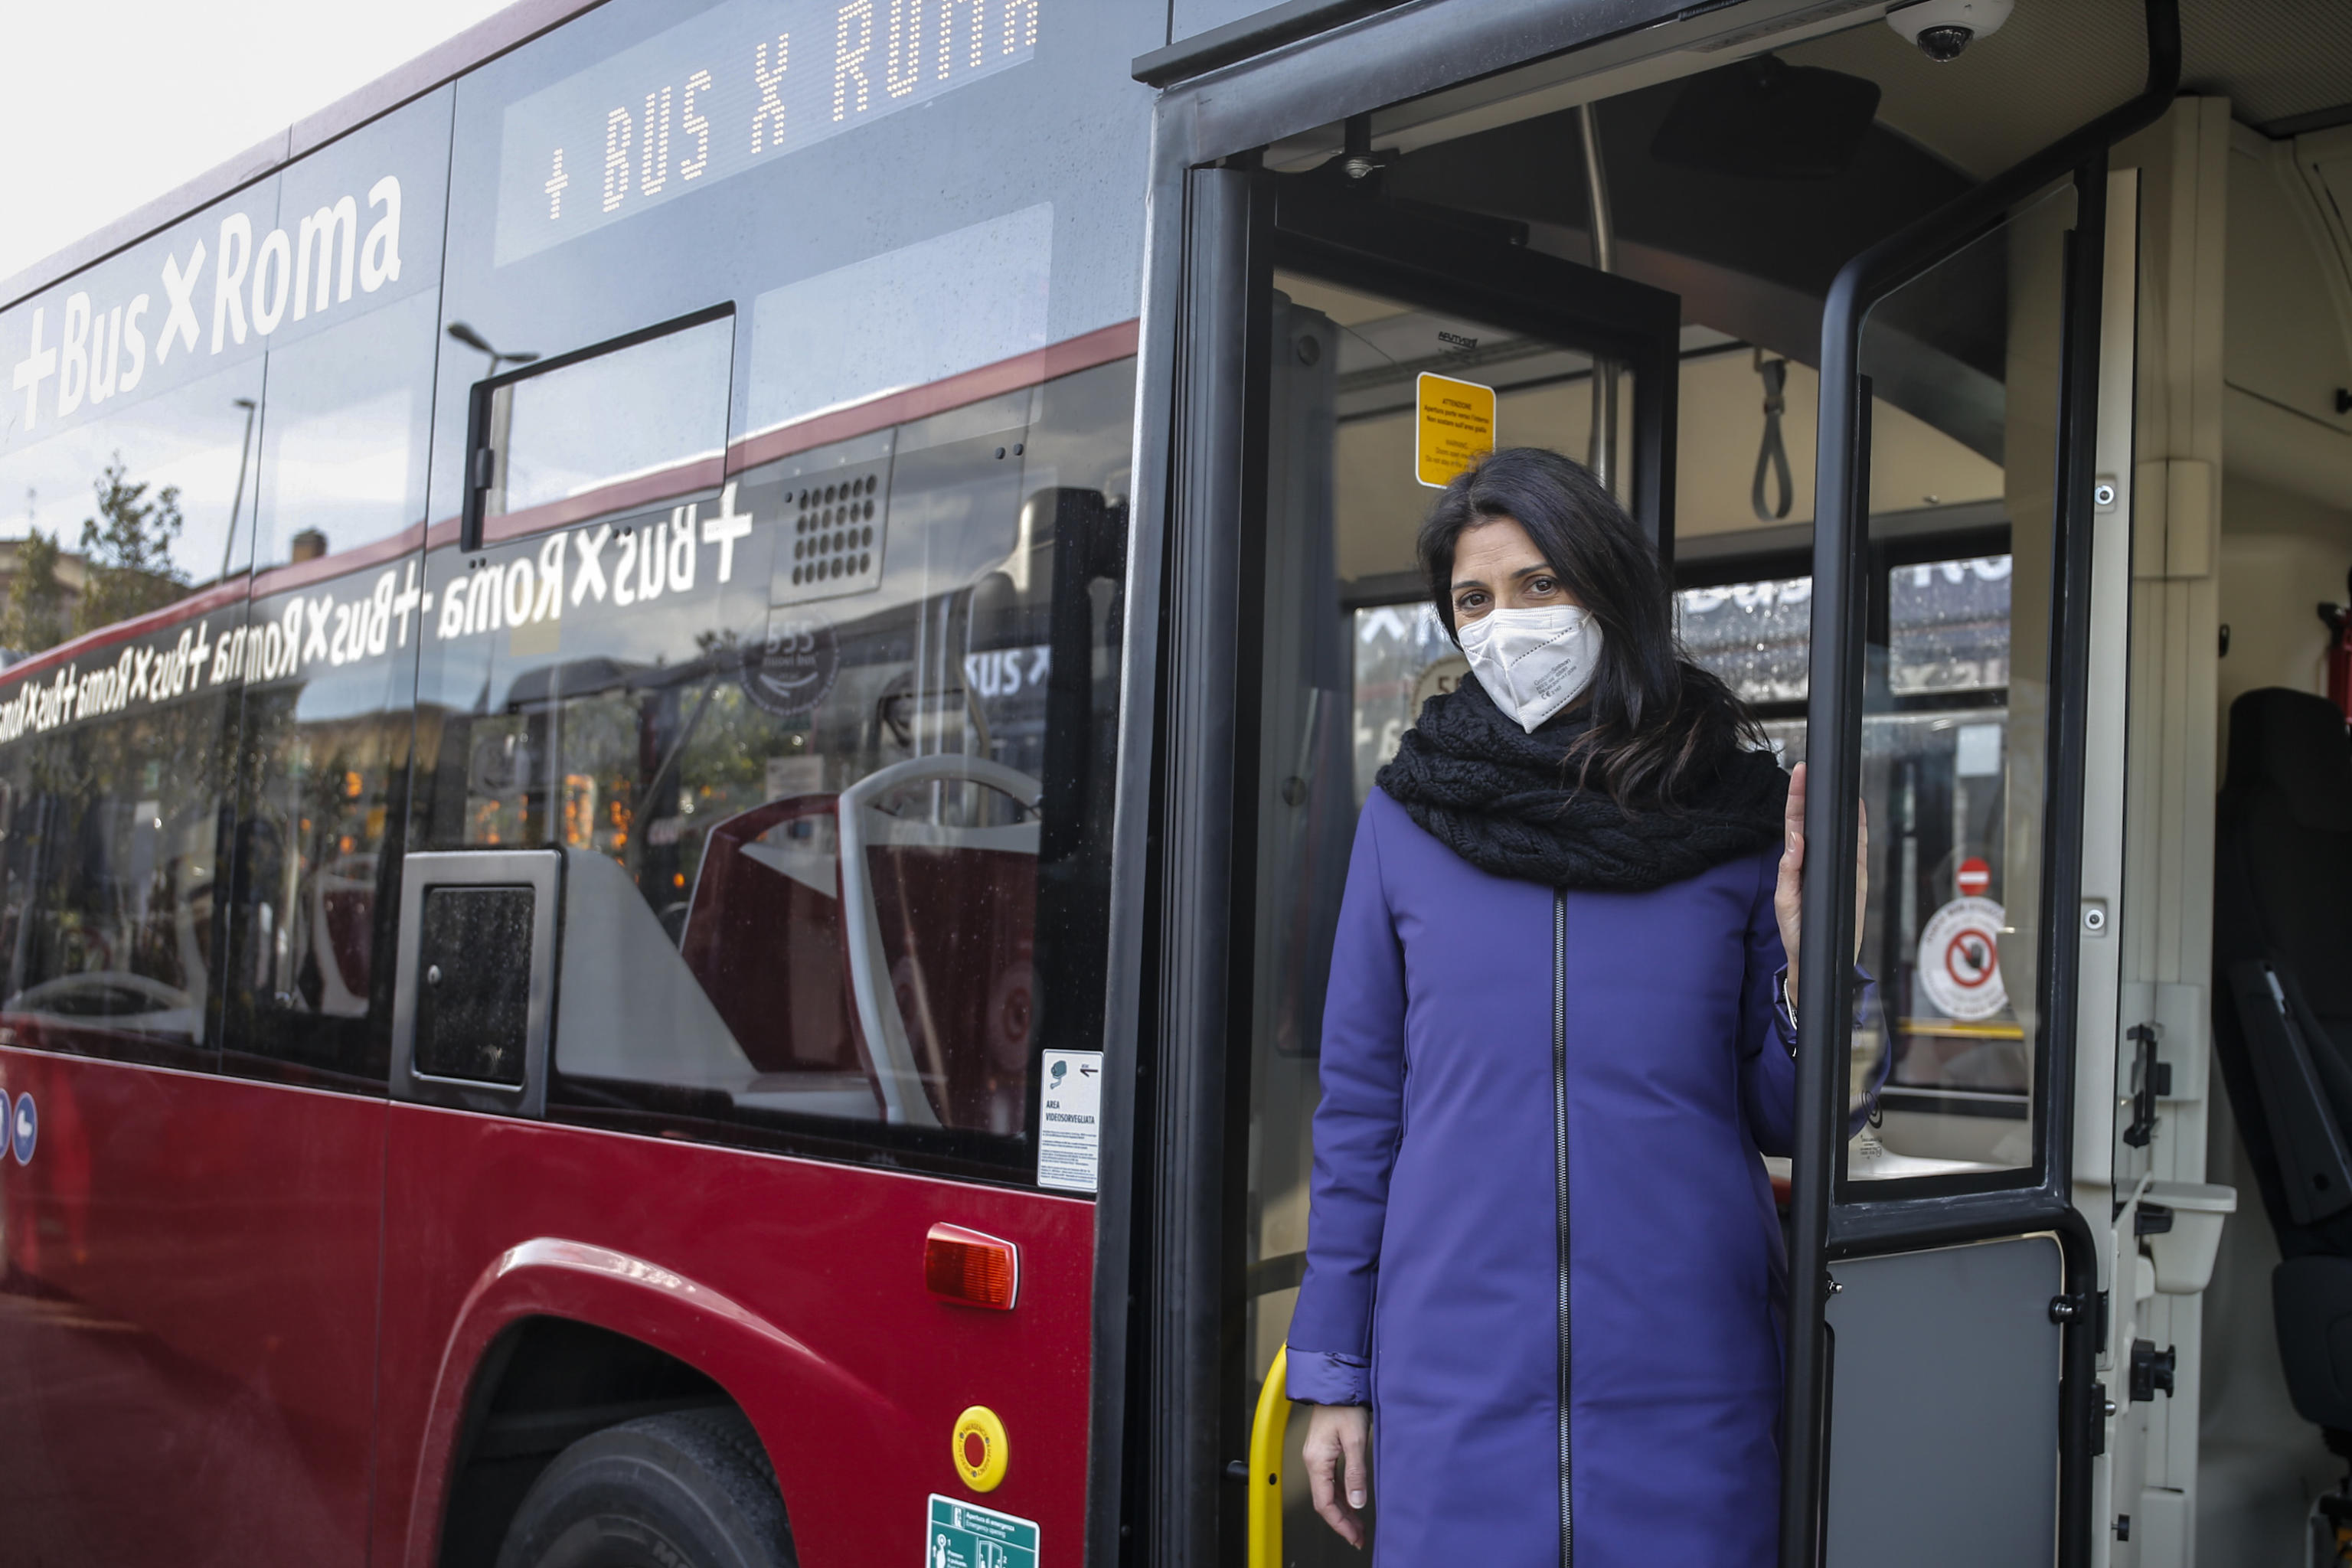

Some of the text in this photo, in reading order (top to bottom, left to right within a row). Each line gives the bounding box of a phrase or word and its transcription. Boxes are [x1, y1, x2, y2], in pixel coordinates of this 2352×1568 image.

[603, 69, 711, 213] BUS
[751, 33, 789, 154] X
[765, 620, 815, 654] 555
[1046, 1100, 1060, 1109] AREA
[1046, 1112, 1095, 1125] VIDEOSORVEGLIATA
